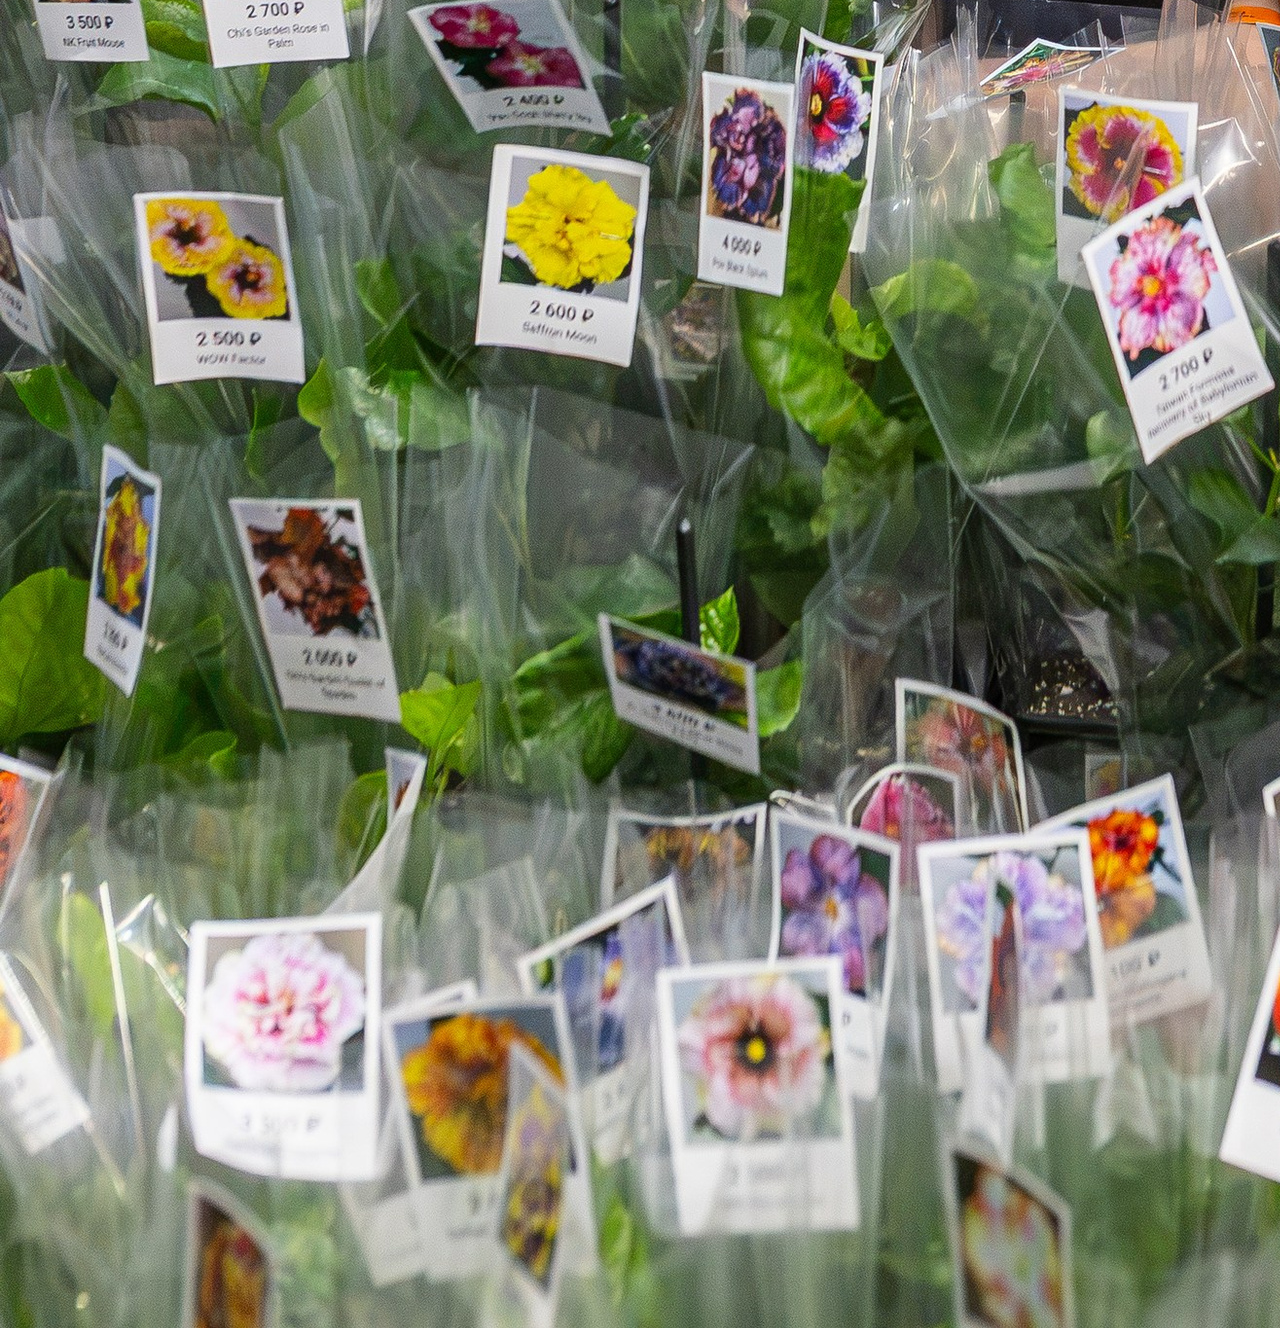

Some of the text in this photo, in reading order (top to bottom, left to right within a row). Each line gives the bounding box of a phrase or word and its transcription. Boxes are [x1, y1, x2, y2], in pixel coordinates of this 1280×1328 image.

[246, 5, 257, 18] 2
[260, 2, 289, 18] 700
[66, 15, 75, 29] 3
[78, 15, 101, 29] 500
[530, 300, 540, 315] 2
[196, 331, 207, 346] 2
